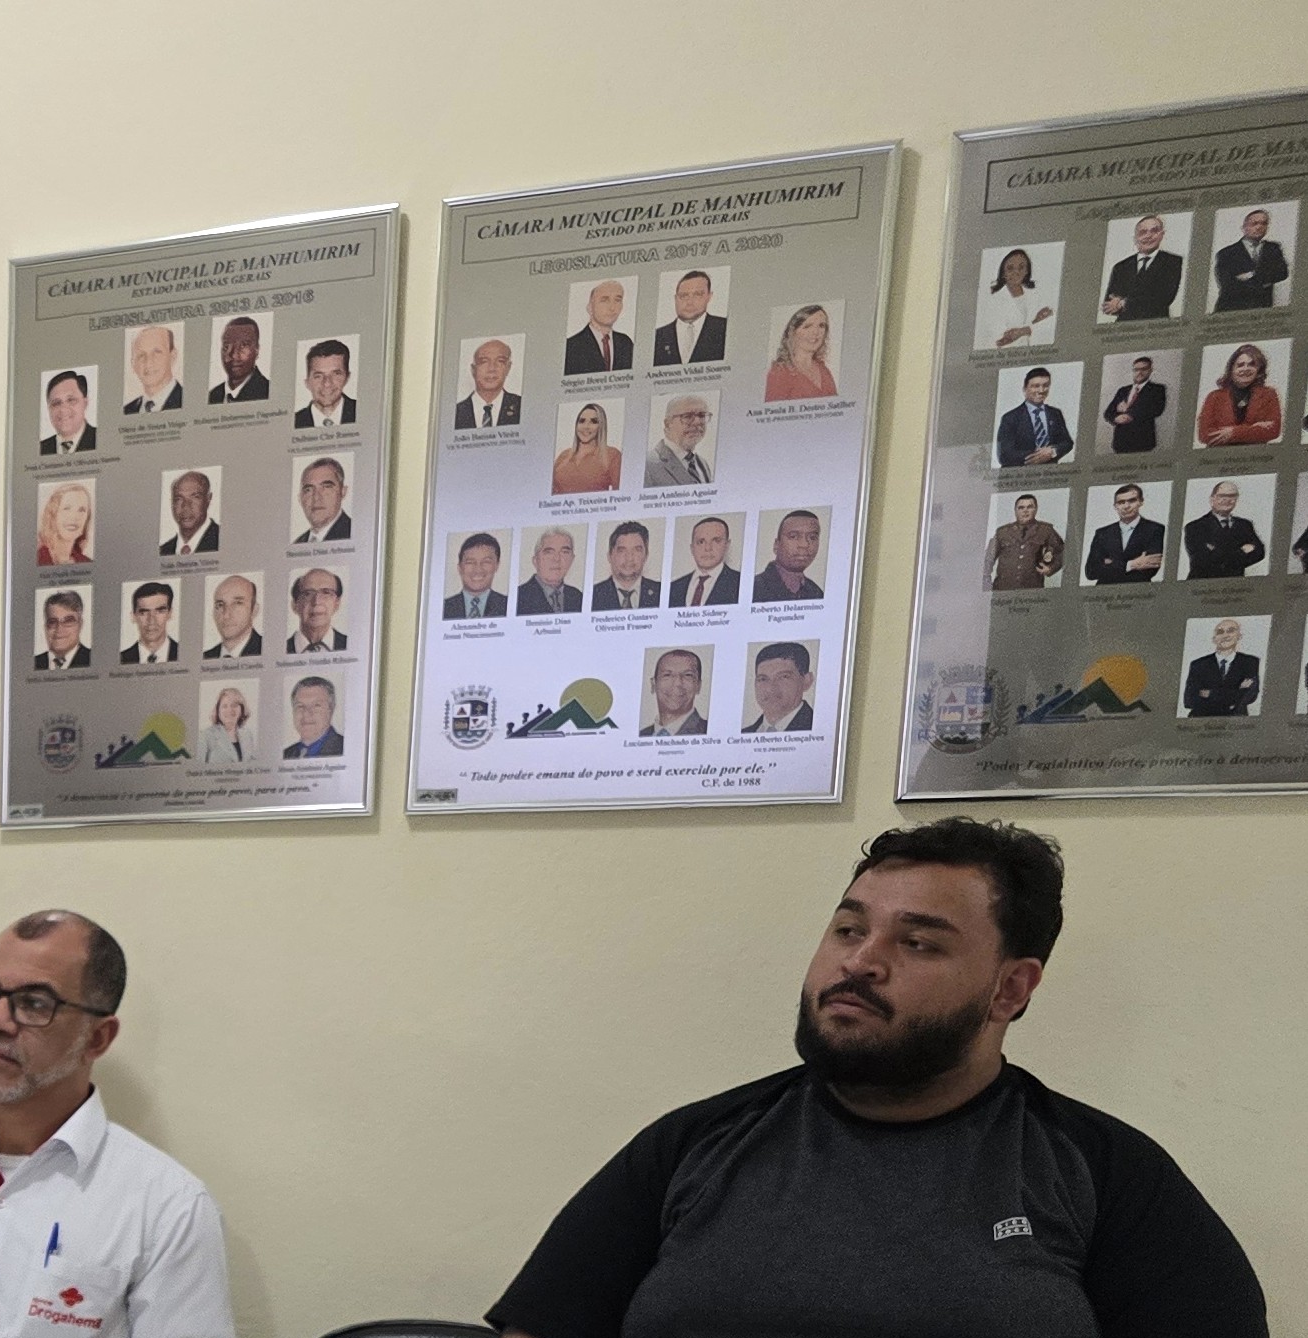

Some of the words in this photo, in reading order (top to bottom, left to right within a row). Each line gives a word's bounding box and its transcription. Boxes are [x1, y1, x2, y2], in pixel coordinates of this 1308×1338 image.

[1007, 164, 1092, 189] CÂMARA
[1097, 149, 1221, 177] MUNICIPAL
[1226, 143, 1260, 162] DE
[478, 213, 555, 240] CÂMARA
[558, 203, 665, 229] MUNICIPAL
[670, 199, 697, 218] DE
[702, 180, 845, 212] MANHUMIRIM
[586, 224, 634, 240] ESTADO
[636, 221, 654, 234] DE
[657, 216, 699, 233] MINAS
[702, 211, 751, 227] GERAIS
[529, 246, 661, 275] LEGISLATURA
[665, 241, 712, 260] 2017
[715, 237, 731, 254] A
[736, 232, 783, 252] 2020
[48, 275, 114, 299] CÂMARA
[117, 262, 209, 287] MUNICIPAL
[213, 257, 237, 275] DE
[241, 242, 361, 270] MANHUMIRIM
[131, 284, 169, 299] ESTADO
[172, 281, 187, 294] DE
[189, 276, 228, 292] MINAS
[230, 270, 271, 287] GERAIS
[89, 303, 205, 331] LEGISLATURA
[470, 770, 498, 782] Todo
[500, 770, 533, 784] poder
[577, 767, 592, 778] do
[594, 769, 624, 781] povo
[636, 765, 662, 777] será
[665, 763, 716, 776] exercido
[719, 765, 741, 778] por
[722, 777, 735, 787] de
[737, 776, 761, 787] 1988
